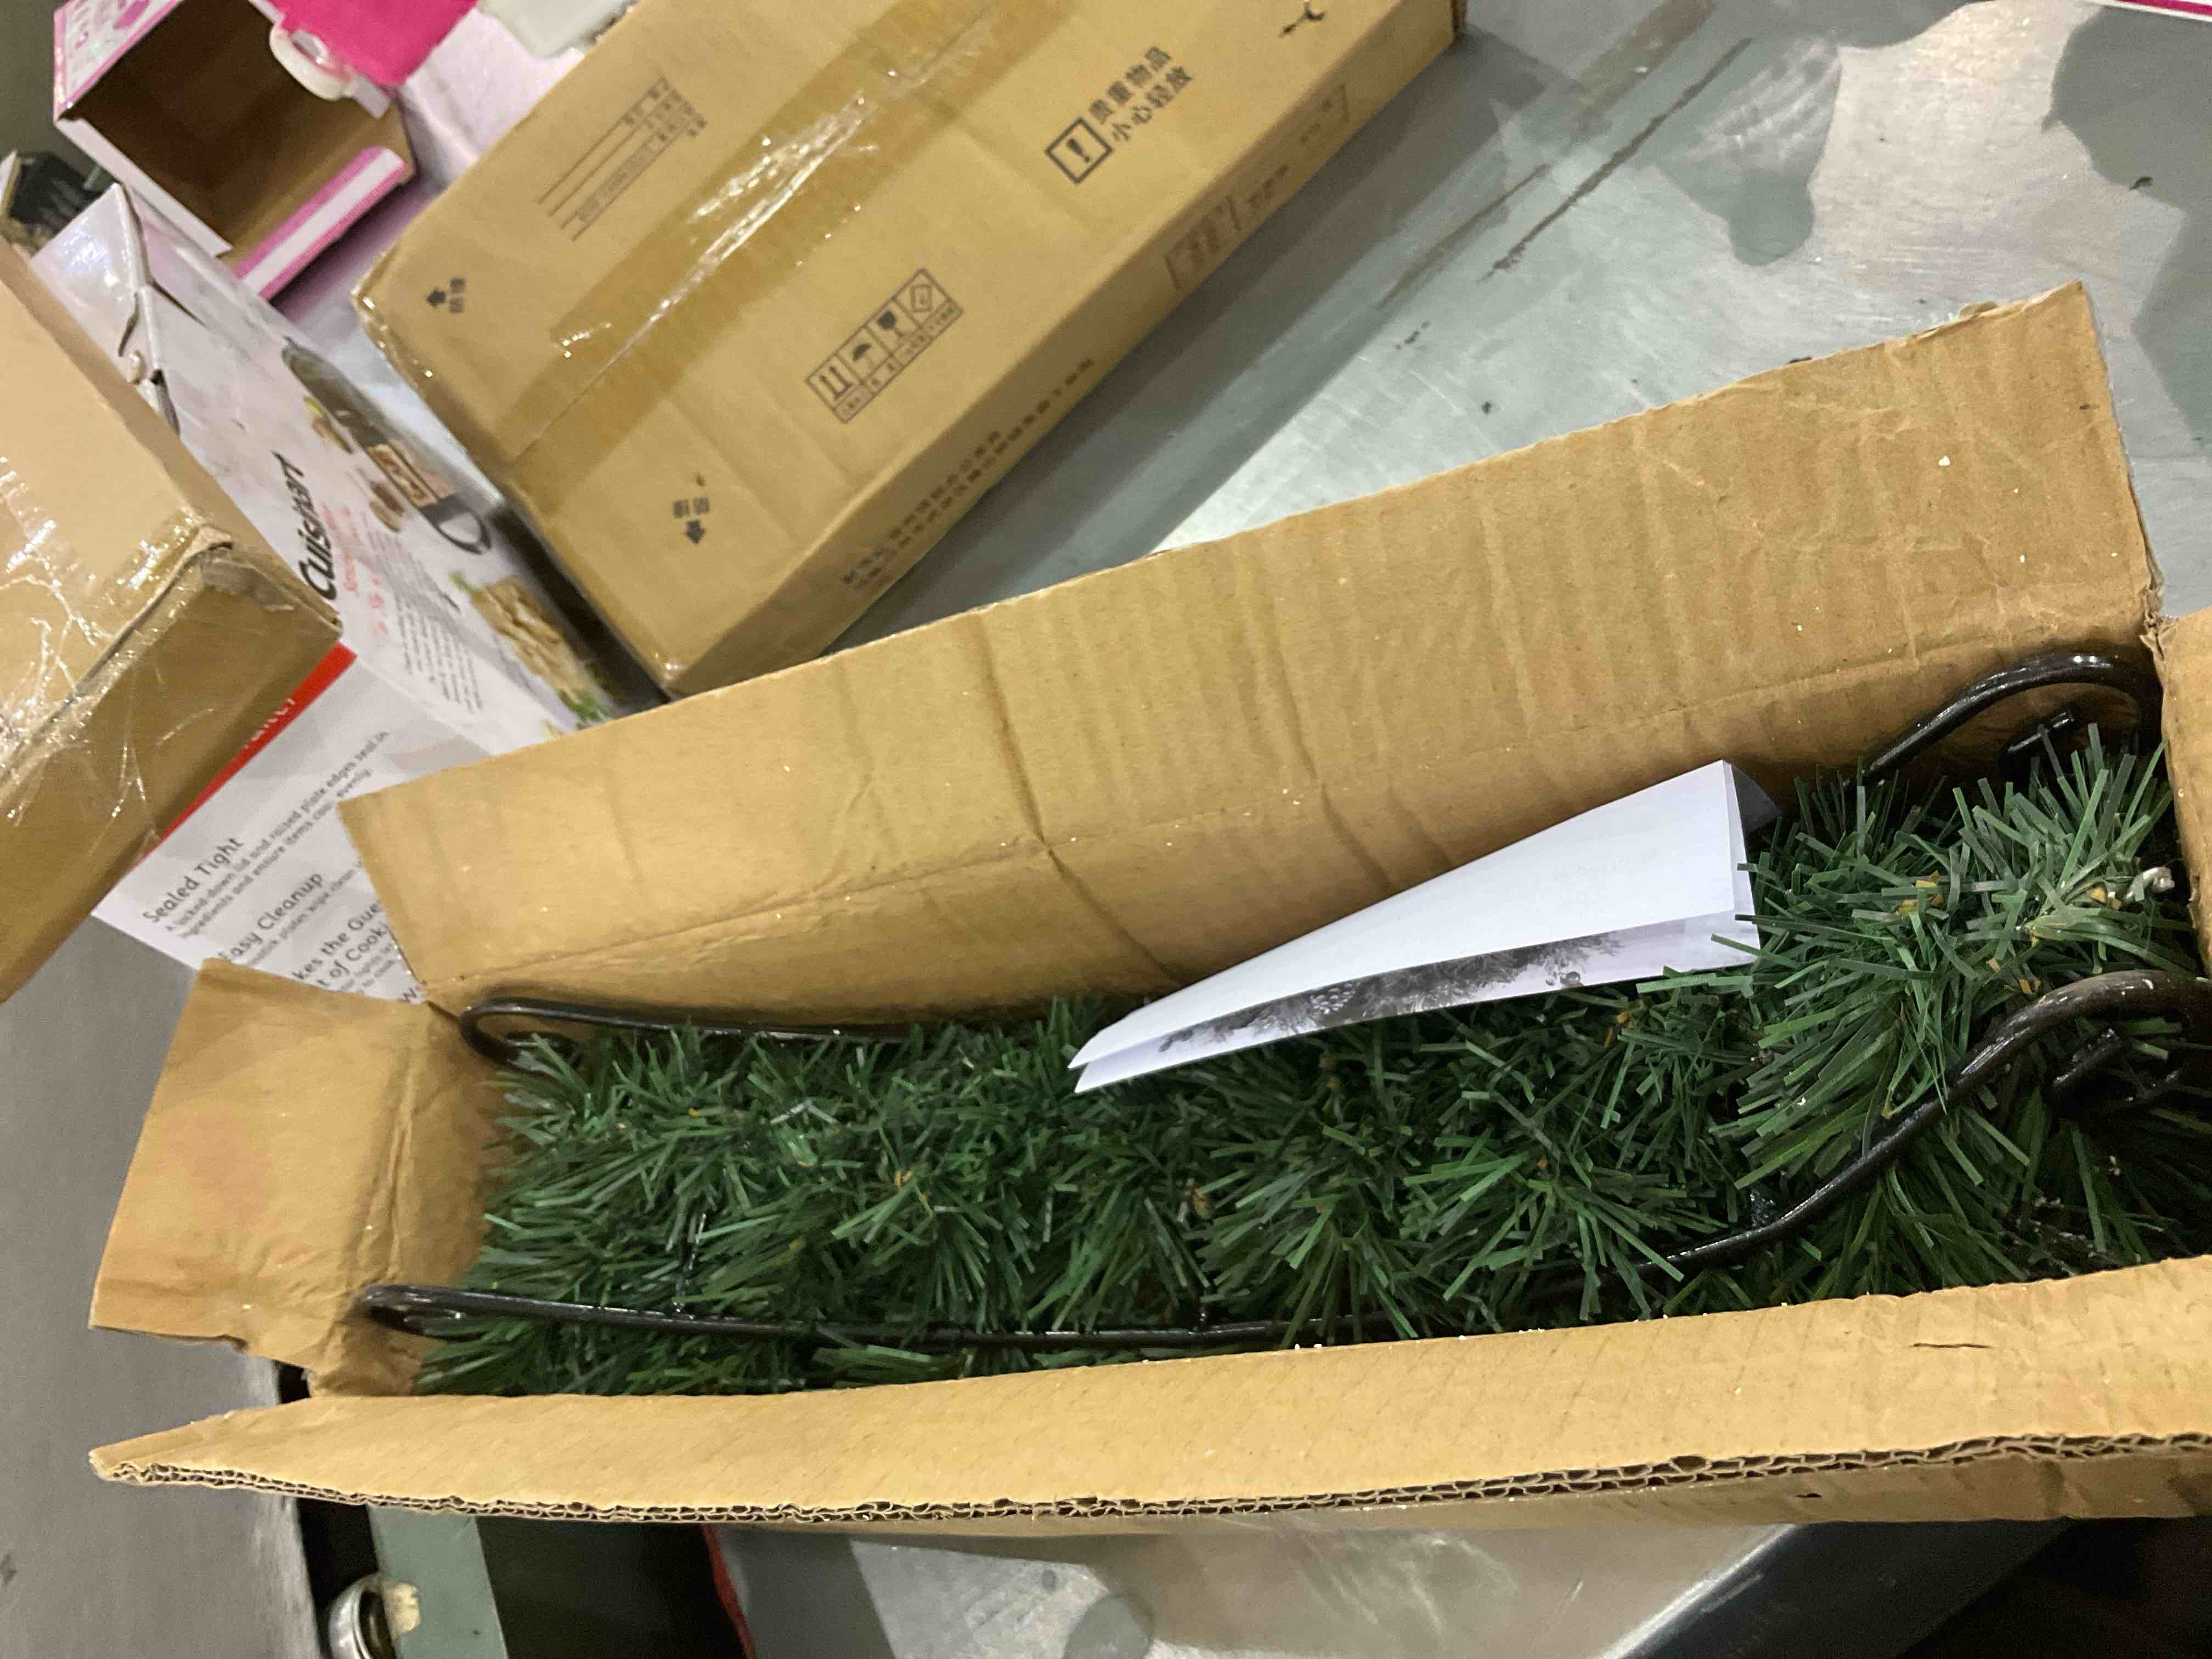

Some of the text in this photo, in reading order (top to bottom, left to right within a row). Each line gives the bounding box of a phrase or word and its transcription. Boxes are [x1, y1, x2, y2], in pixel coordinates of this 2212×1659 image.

[1111, 66, 1194, 141] 小心轻放
[271, 450, 337, 600] Cuisinart
[250, 838, 272, 859] and
[301, 788, 326, 812] plate
[326, 761, 356, 787] edges
[143, 837, 244, 923] Sealed Tight
[233, 875, 254, 895] and
[253, 845, 286, 876] ensure
[257, 873, 323, 930] Cleanup
[321, 932, 351, 956] the
[330, 960, 350, 978] of
